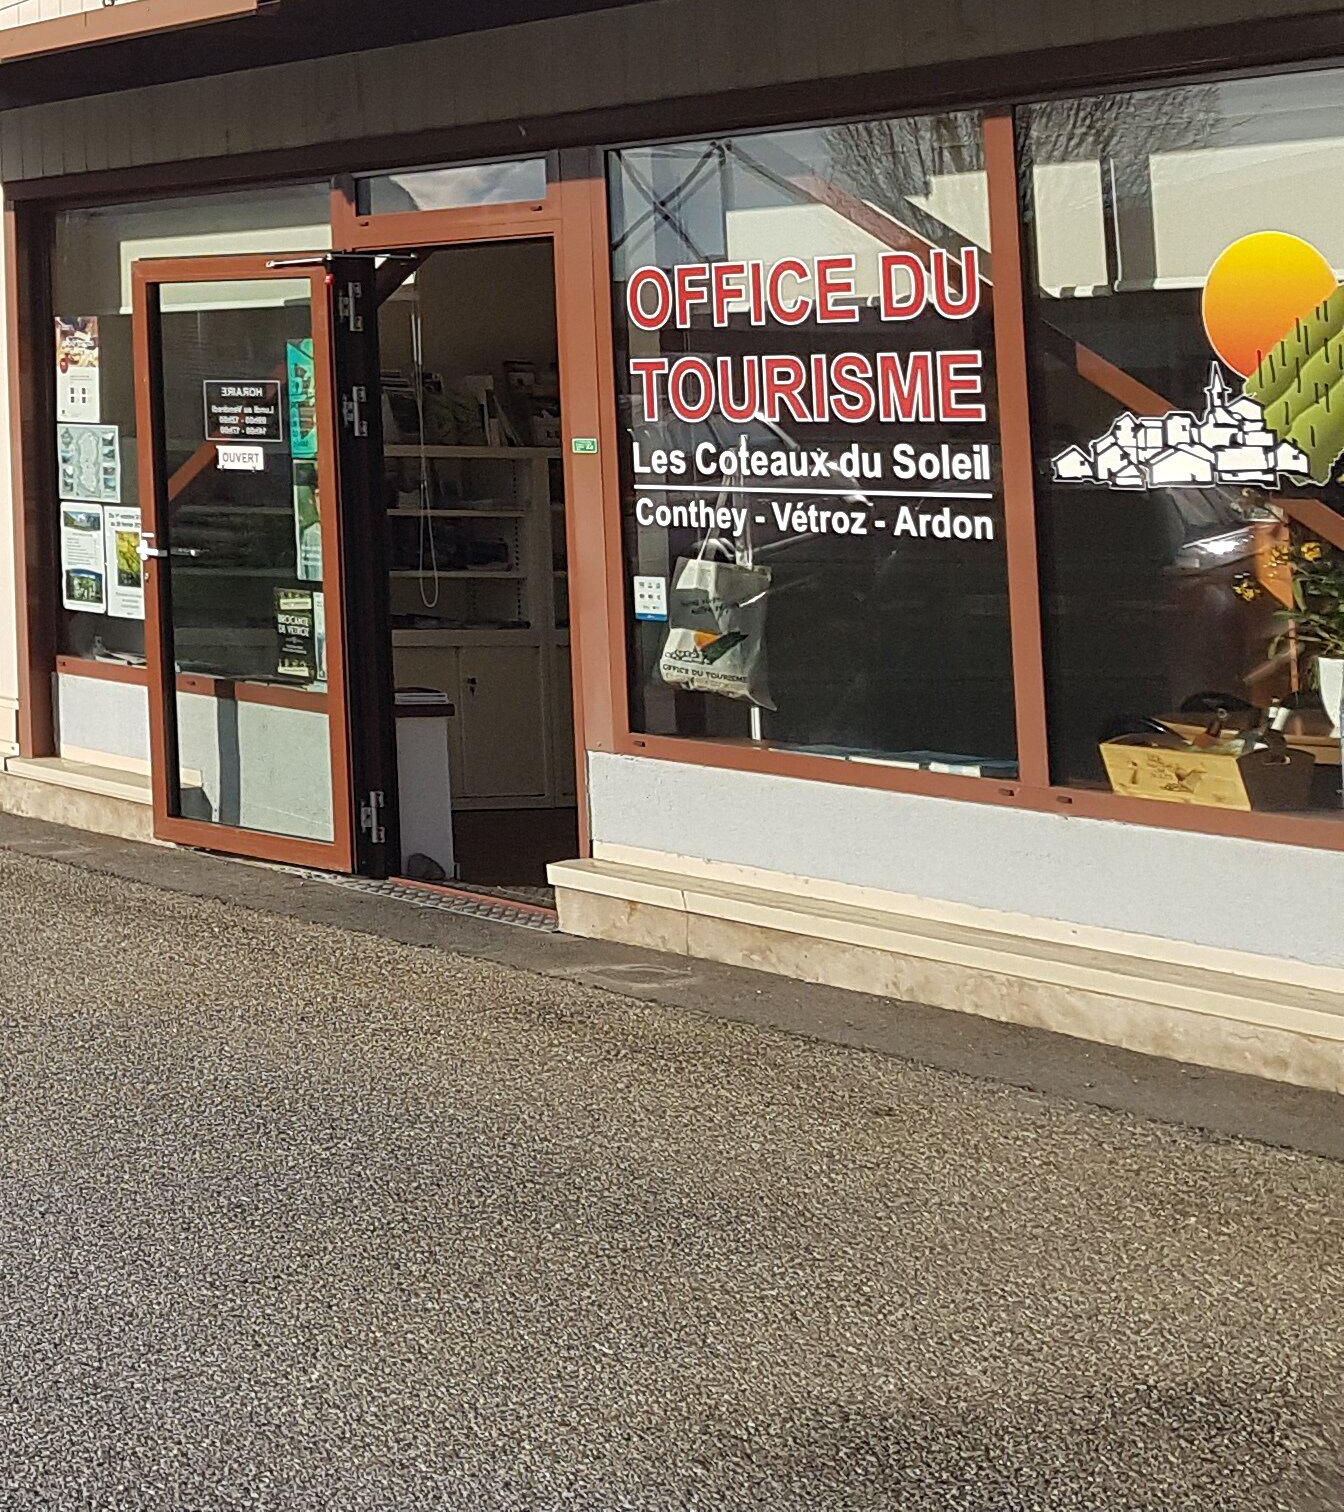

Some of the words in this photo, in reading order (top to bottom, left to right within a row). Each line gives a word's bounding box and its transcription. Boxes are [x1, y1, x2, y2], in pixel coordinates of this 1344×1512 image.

[627, 254, 860, 331] OFFICE
[878, 247, 979, 322] DU
[630, 350, 986, 423] TOURISME
[222, 452, 260, 463] OUVERT
[632, 442, 686, 475] Les
[695, 442, 830, 478] Coteaux
[840, 451, 882, 479] du
[892, 444, 990, 480] Soleil
[635, 498, 748, 537] Conthey
[771, 502, 867, 535] Vétroz
[894, 509, 994, 540] Ardon
